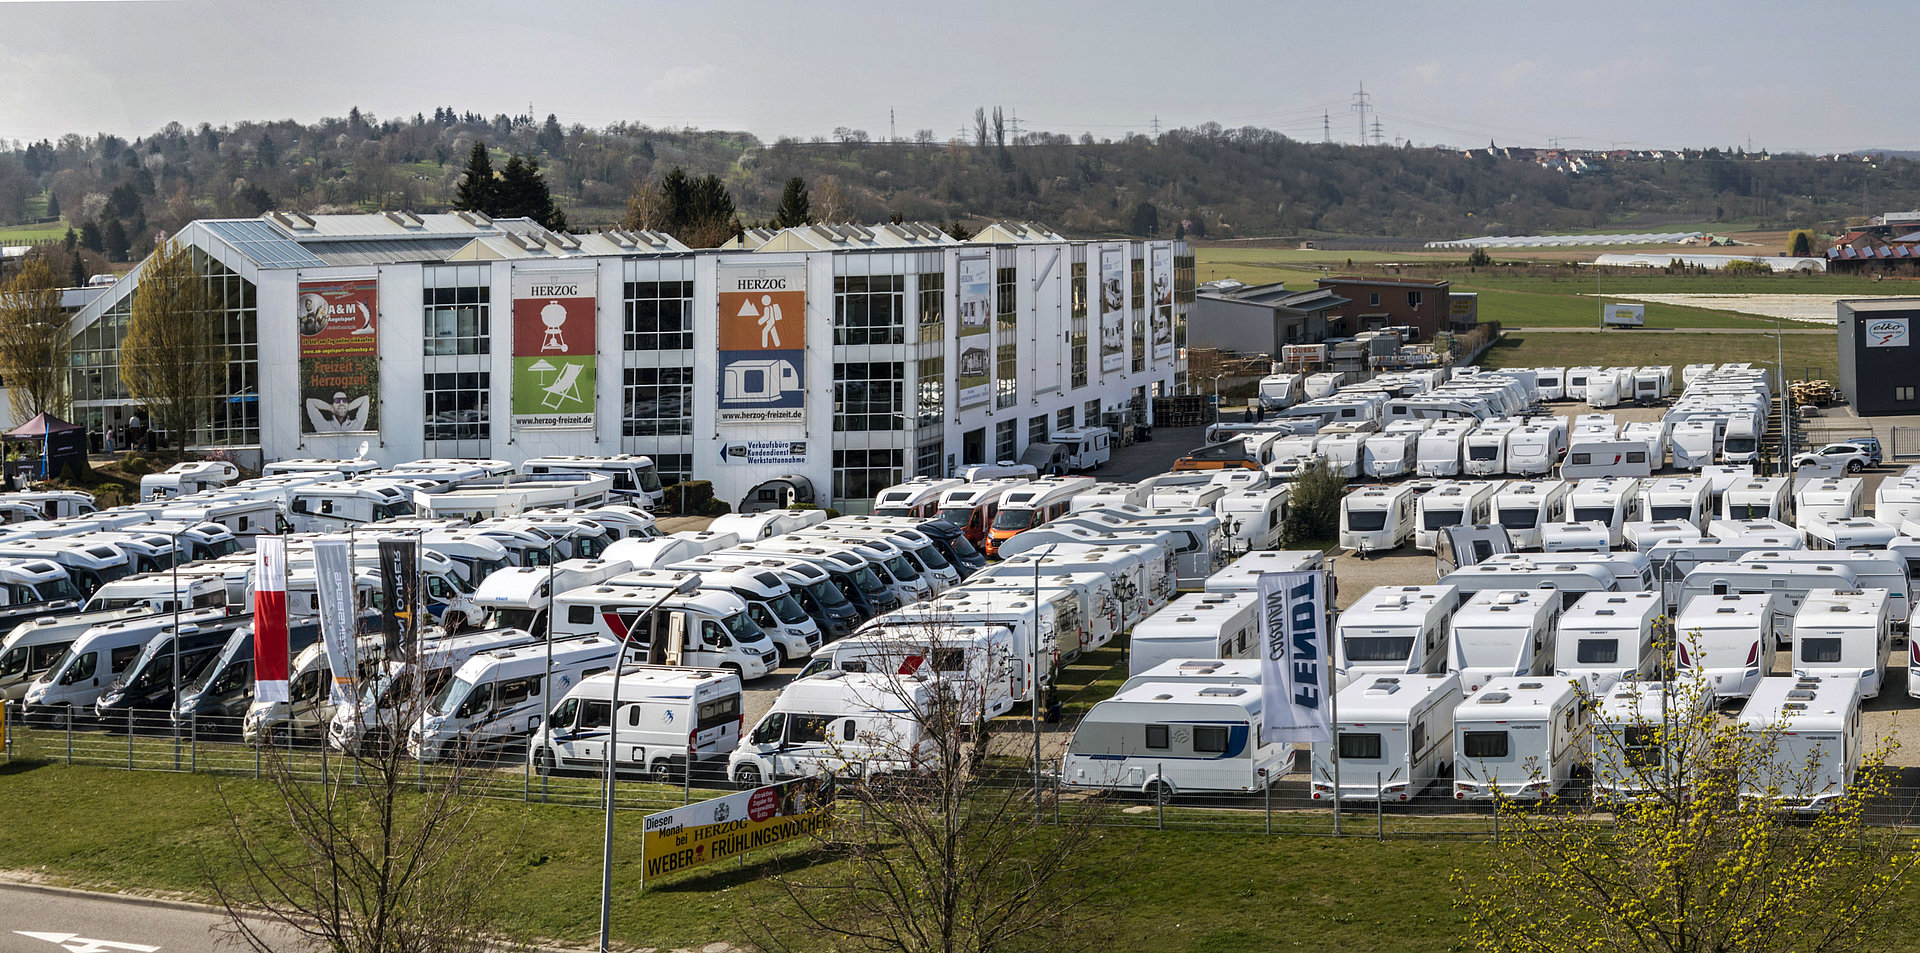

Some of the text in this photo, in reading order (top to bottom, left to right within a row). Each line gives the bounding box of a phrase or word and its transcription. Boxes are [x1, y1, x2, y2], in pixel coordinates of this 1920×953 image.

[738, 279, 786, 290] HERZOG
[531, 285, 578, 296] HERZOG
[328, 304, 356, 314] A&M
[1873, 323, 1903, 331] elko
[314, 361, 354, 373] Freizeit
[311, 374, 367, 388] Herzogzeit
[722, 410, 802, 420] www.herzog-freizeit.de
[515, 416, 592, 426] www.herzog-freizeit.de
[747, 441, 789, 449] Verkaufsbüro
[747, 449, 789, 457] Kundendienst
[747, 457, 806, 465] Werkstattannahme
[646, 815, 673, 830] Diesen
[659, 823, 683, 839] Monat
[676, 818, 748, 846] bei HERZOG
[648, 815, 831, 877] WEBER FRÜHLINGSWOCHEN
